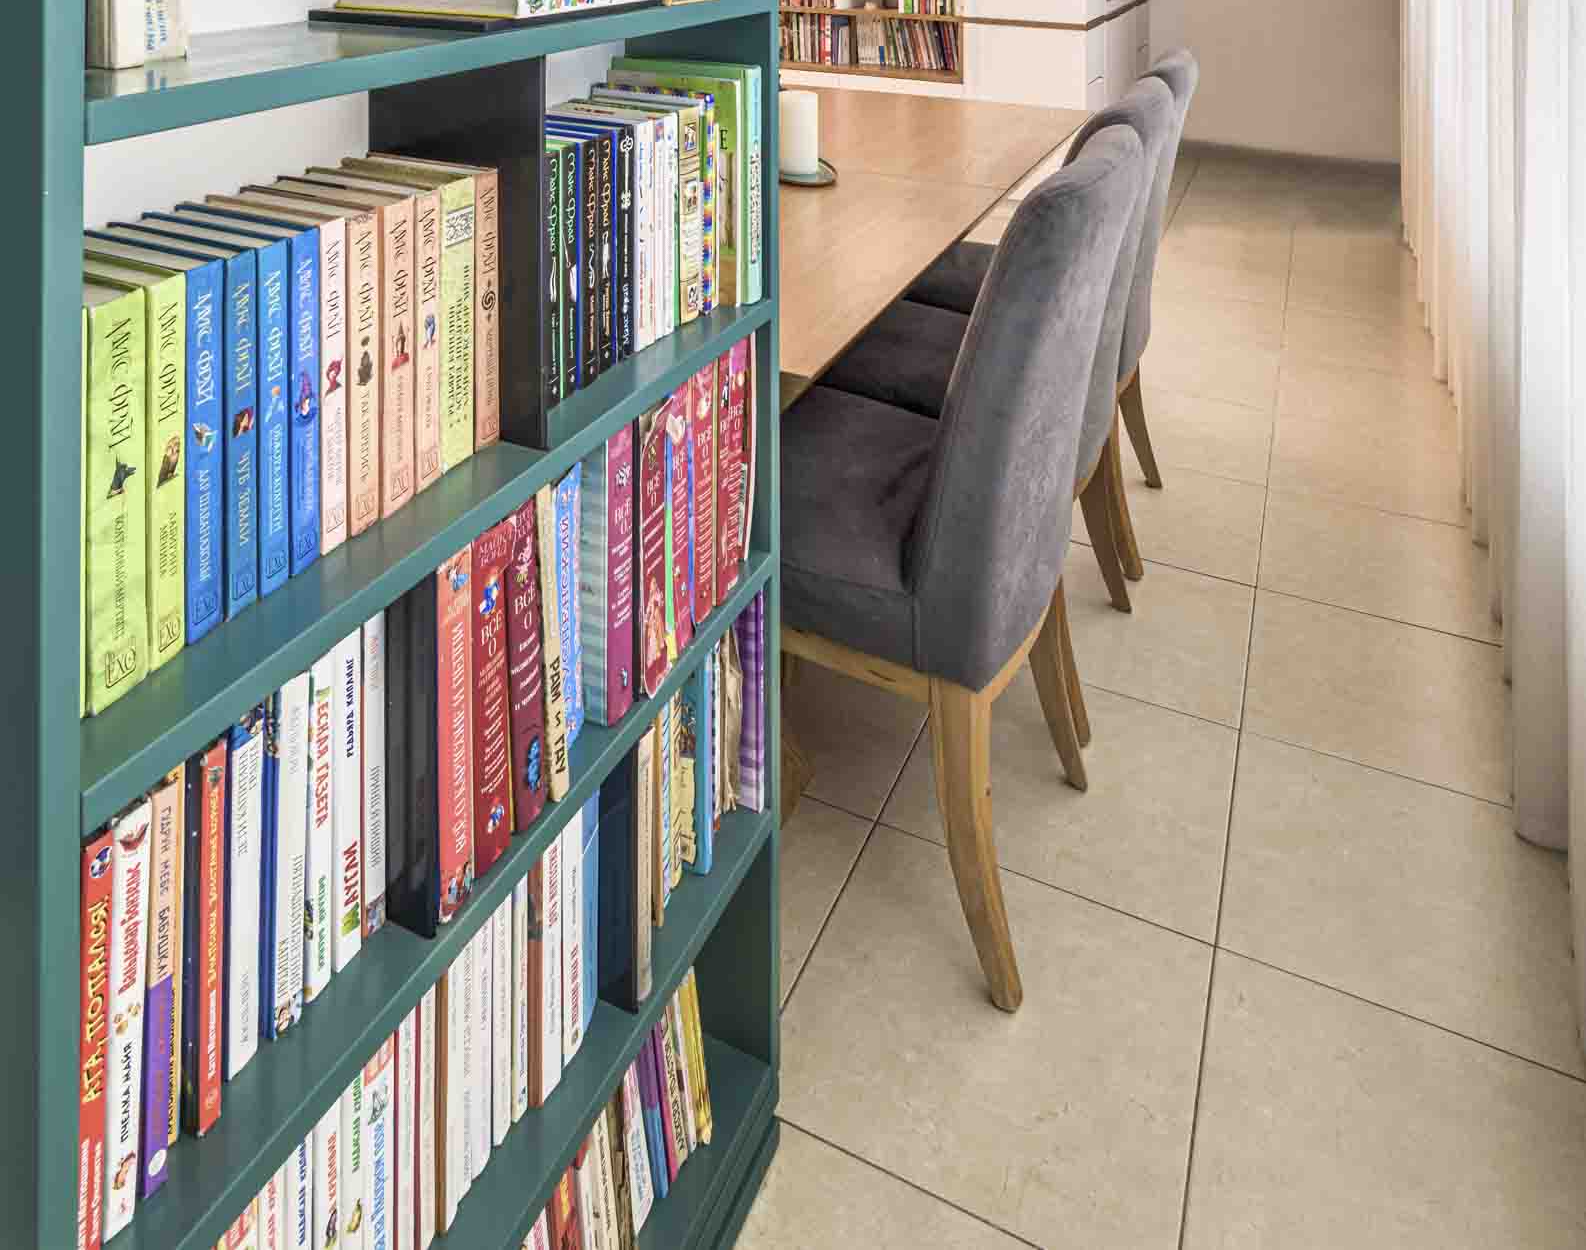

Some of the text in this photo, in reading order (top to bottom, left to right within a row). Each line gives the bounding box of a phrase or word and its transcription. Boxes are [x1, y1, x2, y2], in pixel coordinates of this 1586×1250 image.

[356, 228, 374, 333] МАКС ФРАЙ
[390, 216, 408, 319] МАКС ФРАЙ
[418, 205, 437, 305] МАКС ФРАЙ
[482, 184, 495, 275] МАКС ФРАЙ
[233, 280, 250, 392] МАКС ФРАЙ
[266, 266, 282, 382] МАКС ФРАЙ
[297, 258, 312, 360] МАКС ФРАЙ
[326, 238, 341, 338] МАКС ФРАЙ
[107, 318, 134, 449] МАКС ФРАЙ
[159, 299, 181, 423] МАКС ФРАЙ
[197, 289, 213, 405] МАКС ФРАЙ
[489, 638, 497, 658] О
[524, 610, 532, 630] О
[345, 657, 355, 759] РЕДЬЯРД КИПЛИНГ
[315, 767, 330, 829] ГАЗЕТА
[117, 862, 141, 996] Вальдемар Бонзельс
[154, 805, 172, 977] ГУДРУН МЕБС БАБУШКА!
[83, 900, 111, 1104] АГА, ПОПАЛСЯ!
[119, 1042, 134, 1145] ПЧЕЛКА МАЙЯ
[672, 1101, 685, 1151] АЛЕКСЕЙ
